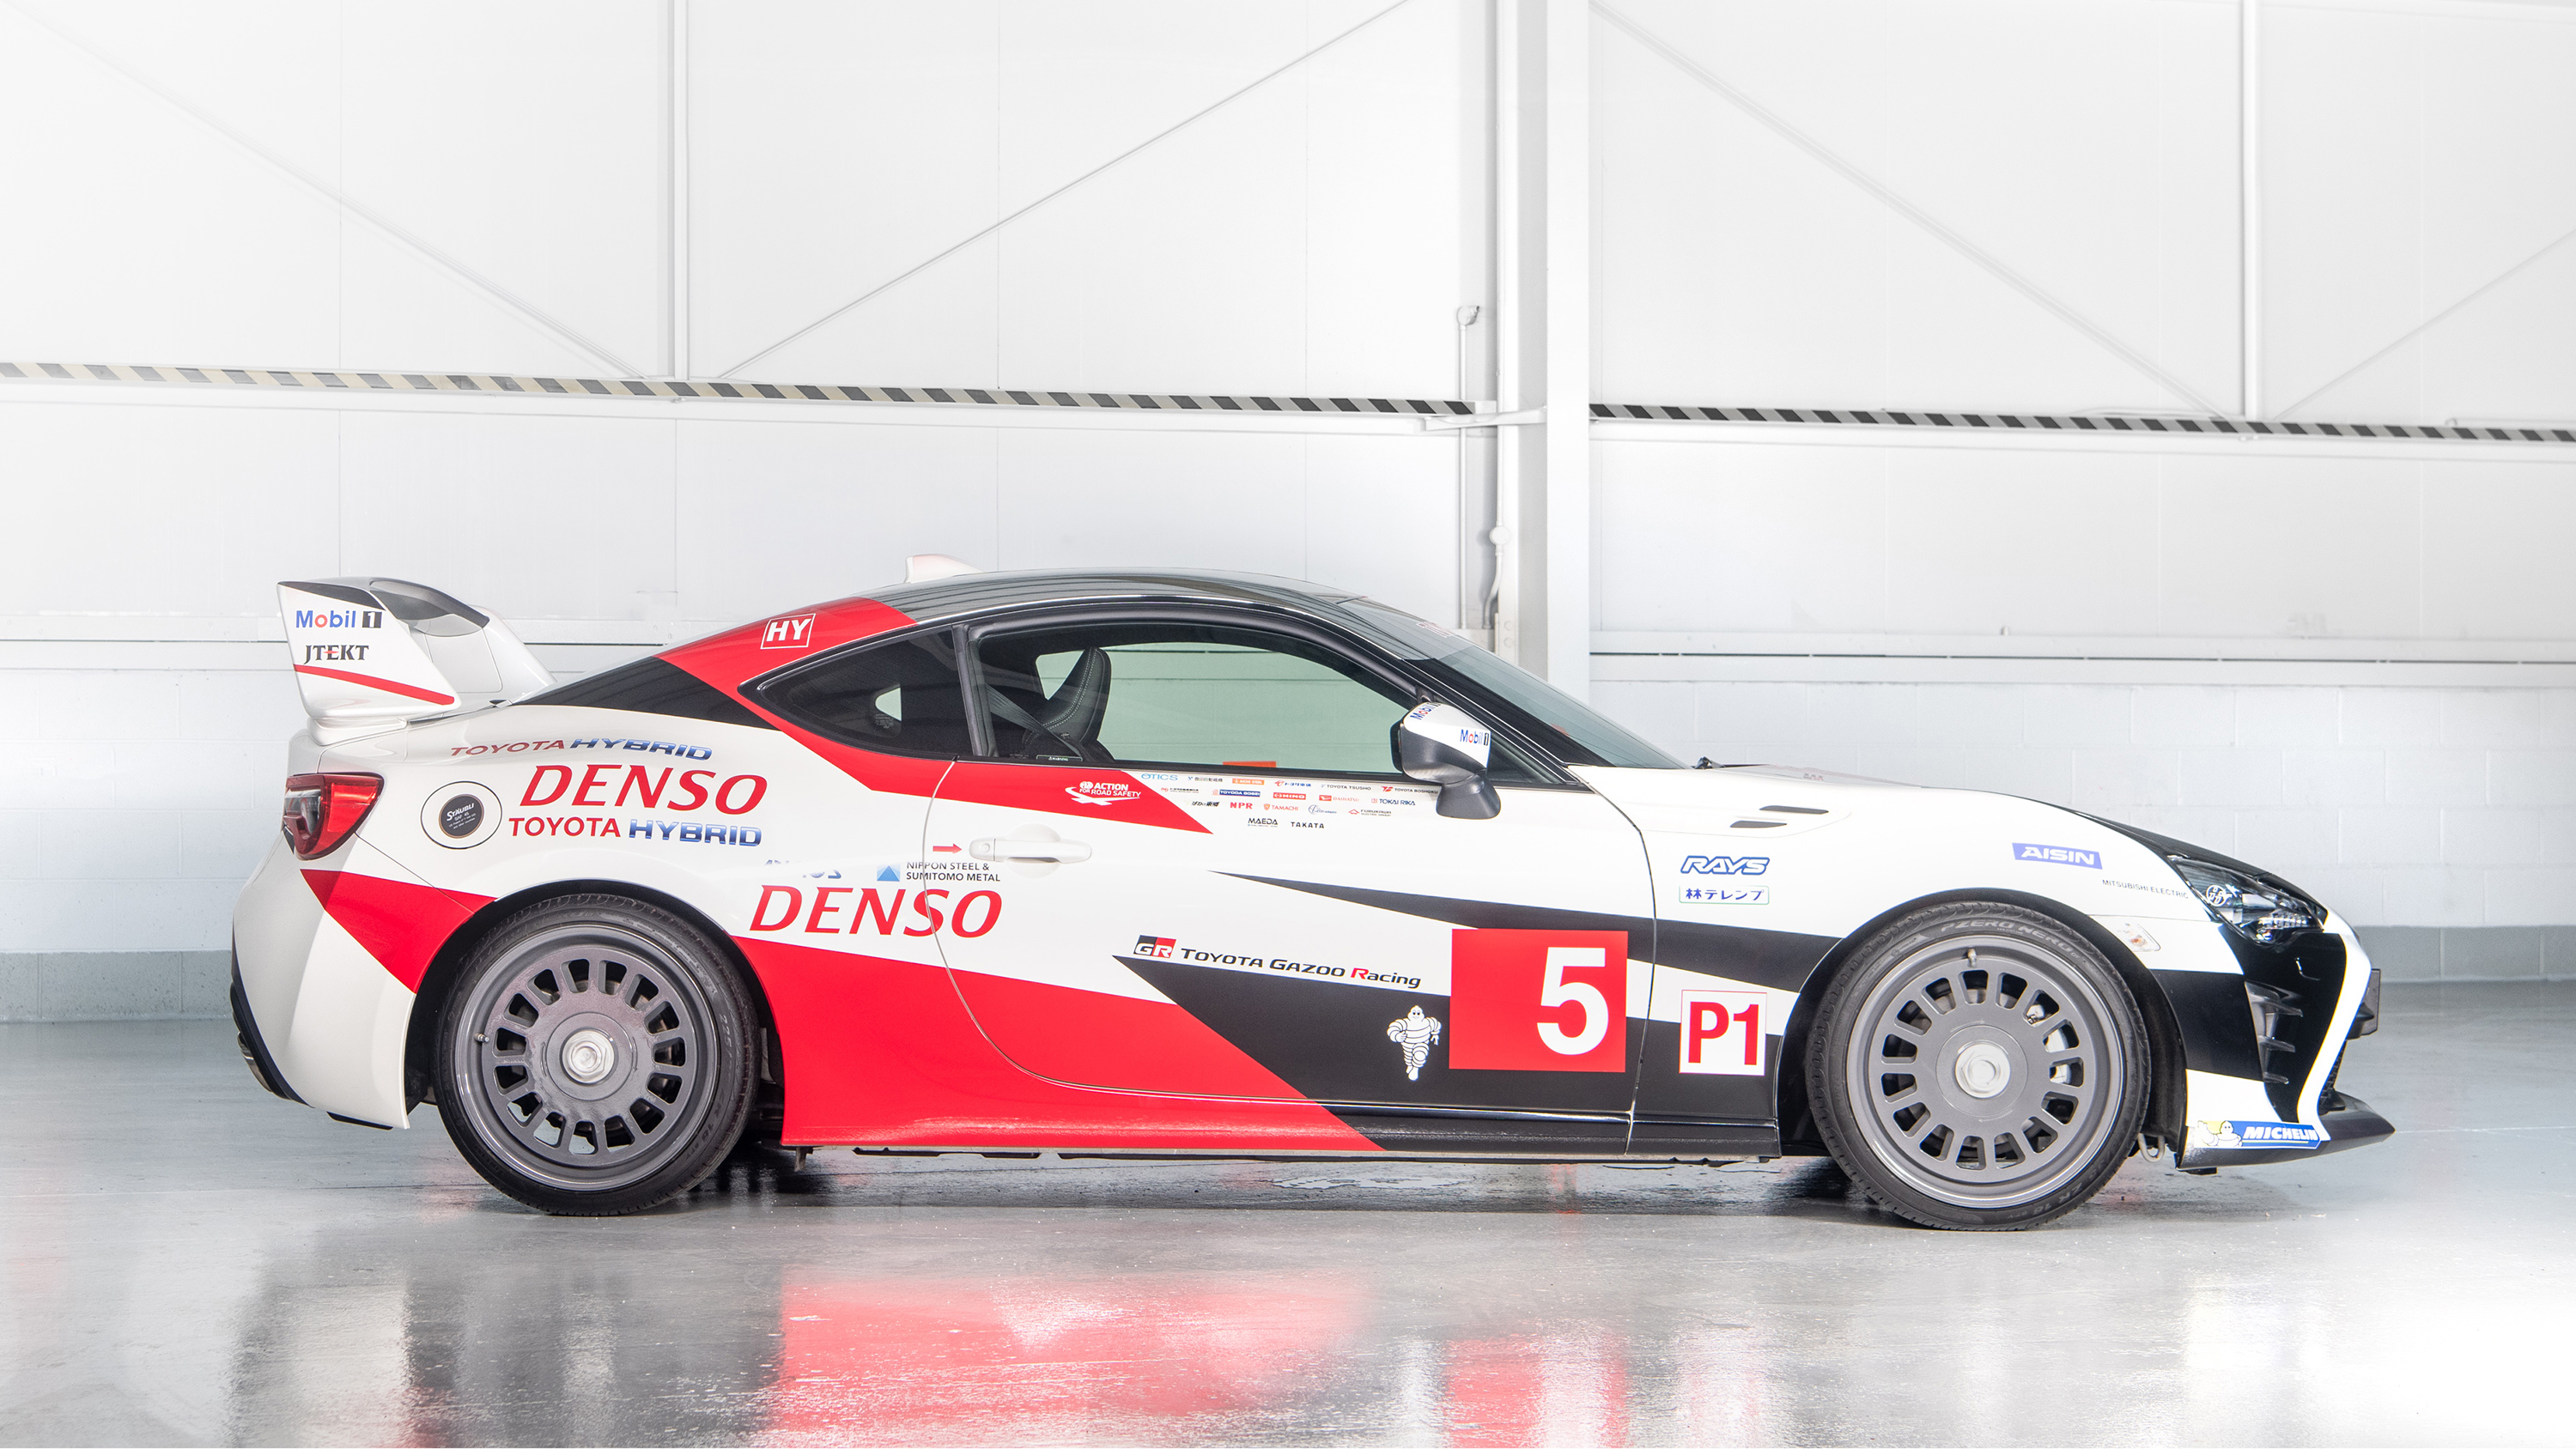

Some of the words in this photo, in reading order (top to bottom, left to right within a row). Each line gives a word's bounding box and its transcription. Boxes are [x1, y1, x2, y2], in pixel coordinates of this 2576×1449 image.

[296, 610, 355, 628] Mobil
[766, 618, 811, 642] HY
[303, 645, 369, 664] JTEKT
[1460, 729, 1483, 745] Mobil
[450, 740, 565, 757] TOYOTA
[569, 738, 713, 761] HYBRID
[519, 764, 768, 815] DENSO
[1094, 782, 1128, 791] ACTION
[508, 817, 621, 838] TOYOTA
[629, 818, 762, 847] HYBRID
[907, 861, 947, 870] NIPPON
[950, 862, 981, 871] STEEL
[982, 863, 990, 871] &
[1680, 855, 1771, 876] RAYS
[2020, 846, 2095, 866] AISIN
[906, 871, 964, 881] SUMITOMO
[967, 872, 1000, 882] METAL
[1686, 888, 1765, 901] 林テレンプ
[2102, 879, 2148, 892] MITSUBISHI
[2150, 886, 2189, 899] ELECTRIC
[749, 885, 1003, 938] DENSO
[1133, 941, 1174, 959] GR
[1181, 948, 1264, 968] TOYOTA
[1268, 959, 1346, 978] GAZOO
[1350, 967, 1421, 989] Racing
[1536, 947, 1609, 1056] 5
[1688, 1000, 1759, 1066] P1
[2243, 1126, 2318, 1141] MICHELIN
